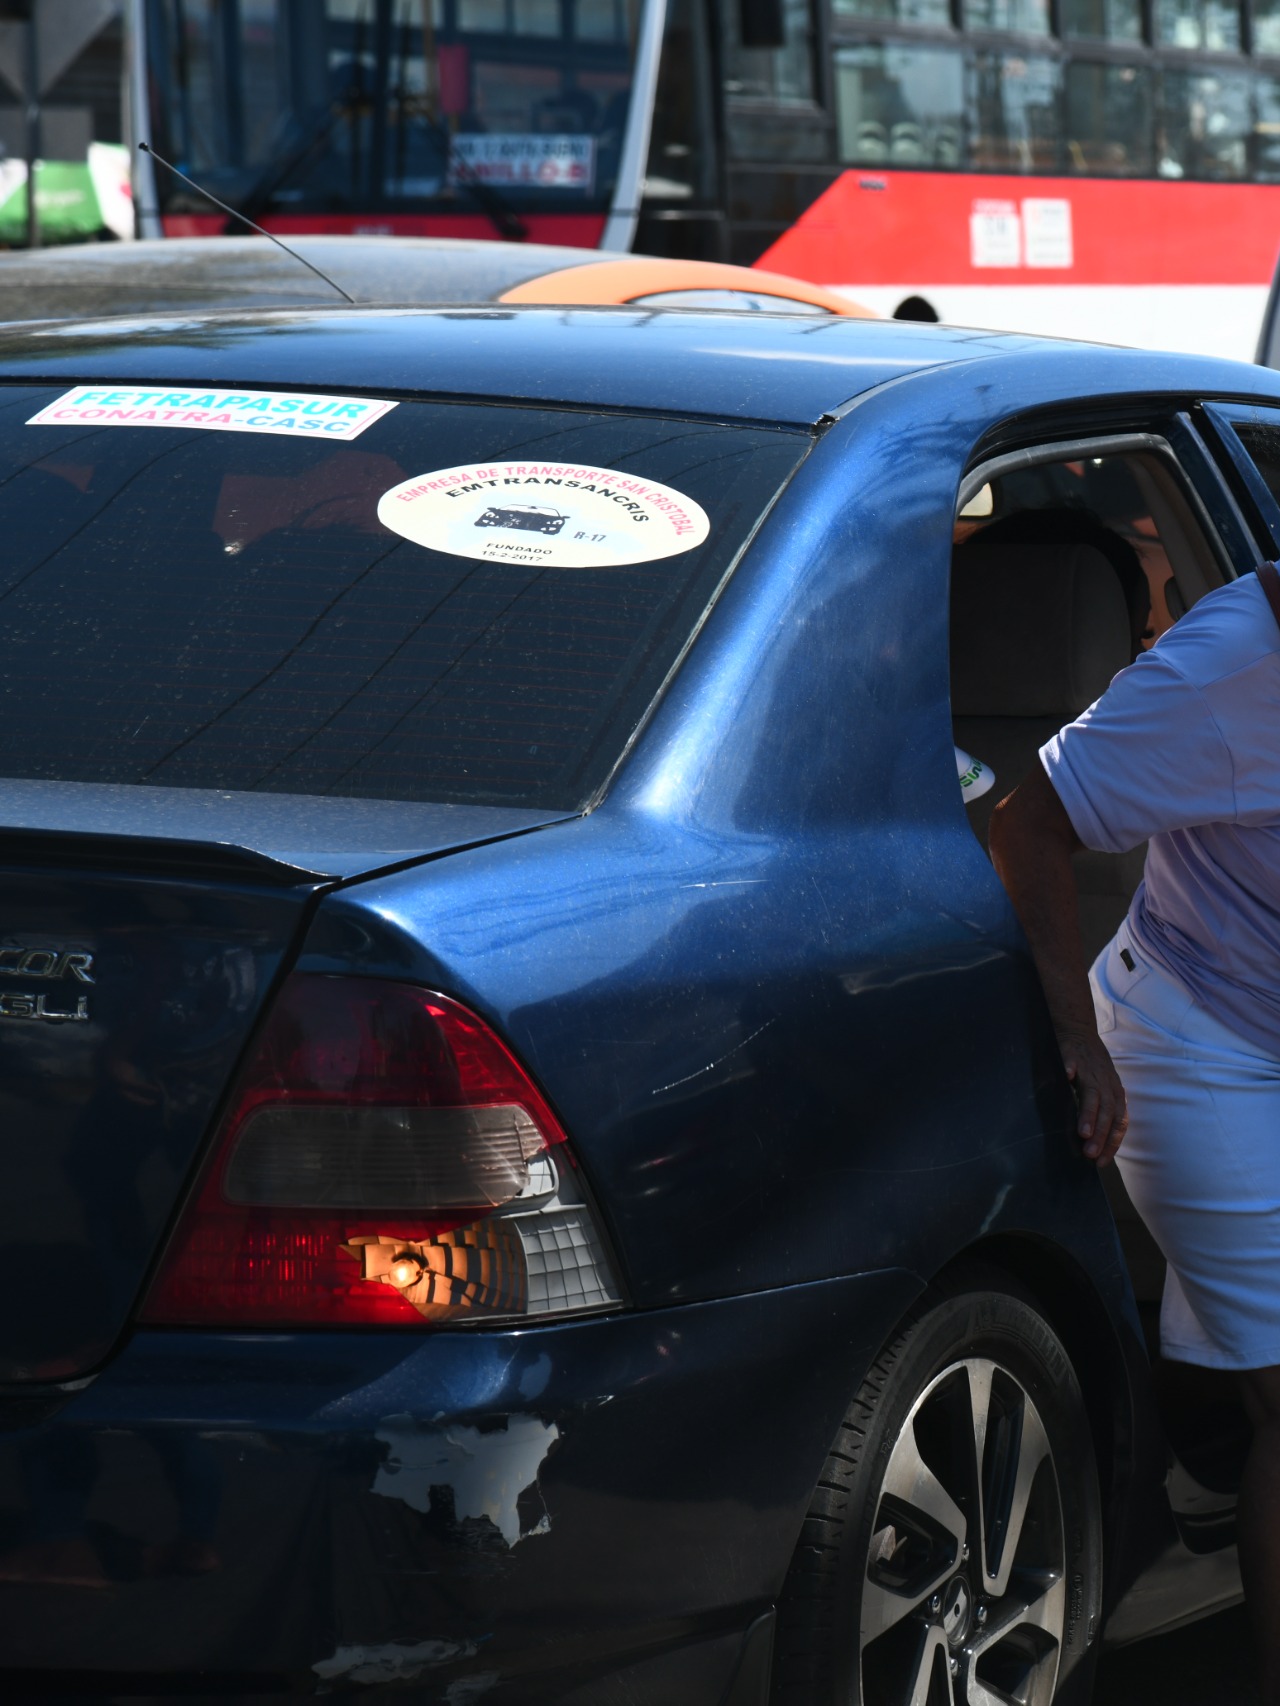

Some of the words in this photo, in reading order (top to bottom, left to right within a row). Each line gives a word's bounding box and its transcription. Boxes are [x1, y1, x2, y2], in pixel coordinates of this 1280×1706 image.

[73, 391, 367, 418] FETRAPASUR
[52, 408, 351, 432] CONATRA-CASC
[396, 473, 473, 502] EMPRESA
[476, 468, 500, 479] DE
[504, 466, 619, 485] TRANSPORTE
[616, 480, 651, 495] SAN
[644, 492, 695, 536] CRISTOBAL
[445, 477, 650, 522] EMTRANSANCRIS
[486, 542, 553, 556] FUNDADO
[573, 531, 607, 543] R-17
[481, 550, 544, 563] 15-2-2017
